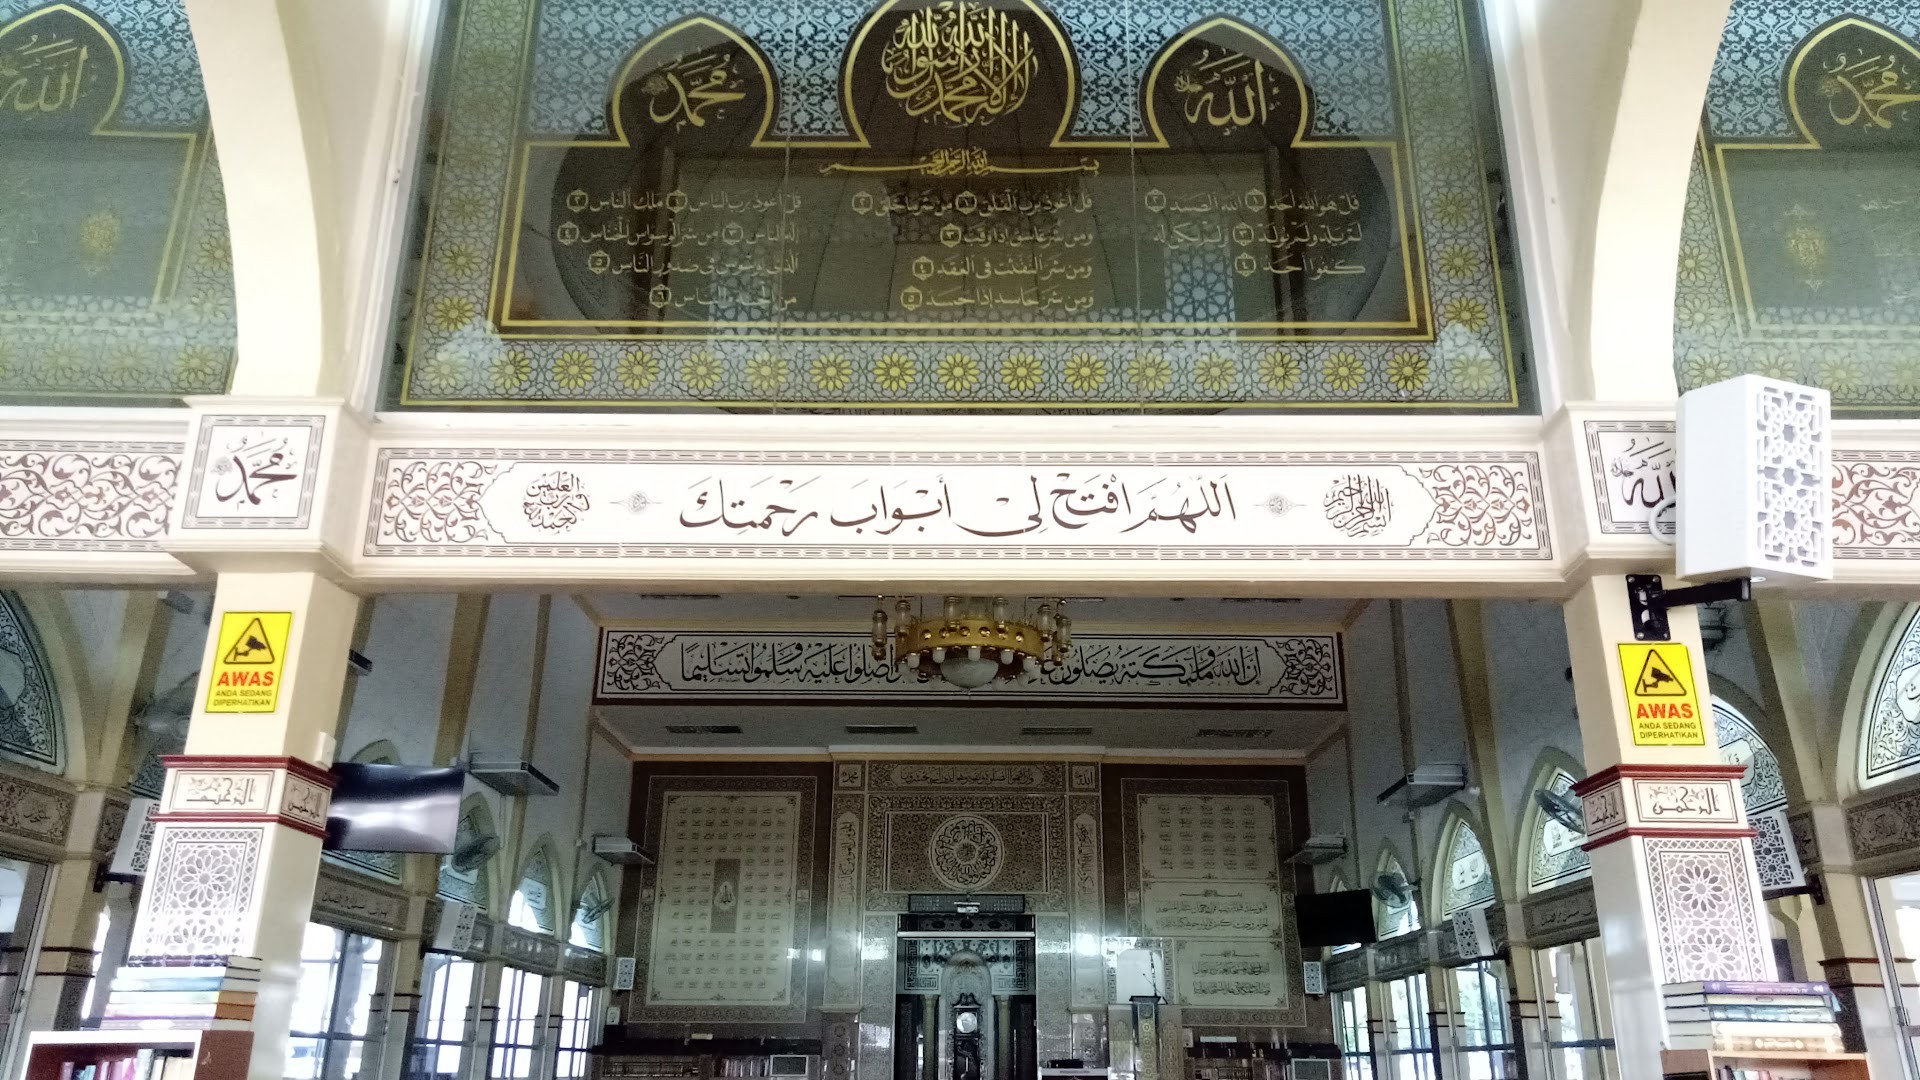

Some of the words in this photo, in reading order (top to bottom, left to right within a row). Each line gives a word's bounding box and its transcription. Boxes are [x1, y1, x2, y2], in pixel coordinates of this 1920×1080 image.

[650, 70, 746, 128] محمد
[1184, 58, 1267, 127] الله
[590, 191, 630, 211] الناس
[979, 189, 1017, 217] الفلق
[1074, 192, 1094, 213] قل
[1170, 193, 1219, 212] الصمد
[1221, 195, 1242, 211] الله
[1298, 191, 1319, 210] الله
[1317, 200, 1338, 217] هو
[1339, 192, 1360, 215] قل
[1065, 233, 1093, 247] ومن
[1153, 224, 1166, 243] له
[1169, 222, 1200, 249] يكن
[1196, 221, 1230, 248] ولم
[1258, 223, 1290, 248] يولد
[1285, 221, 1319, 249] ولم
[1319, 224, 1345, 247] يلد
[1340, 221, 1363, 246] لم
[612, 251, 654, 275] الناس
[937, 256, 975, 275] العقد
[1066, 260, 1093, 279] ومن
[926, 290, 975, 306] حسد
[994, 286, 1039, 306] حاسد
[1065, 295, 1094, 311] ومن
[215, 443, 298, 508] محمد
[217, 671, 274, 686] AWAS
[1636, 703, 1694, 719] AWAS
[1638, 722, 1661, 730] ANDA
[1663, 722, 1697, 730] SEDANG
